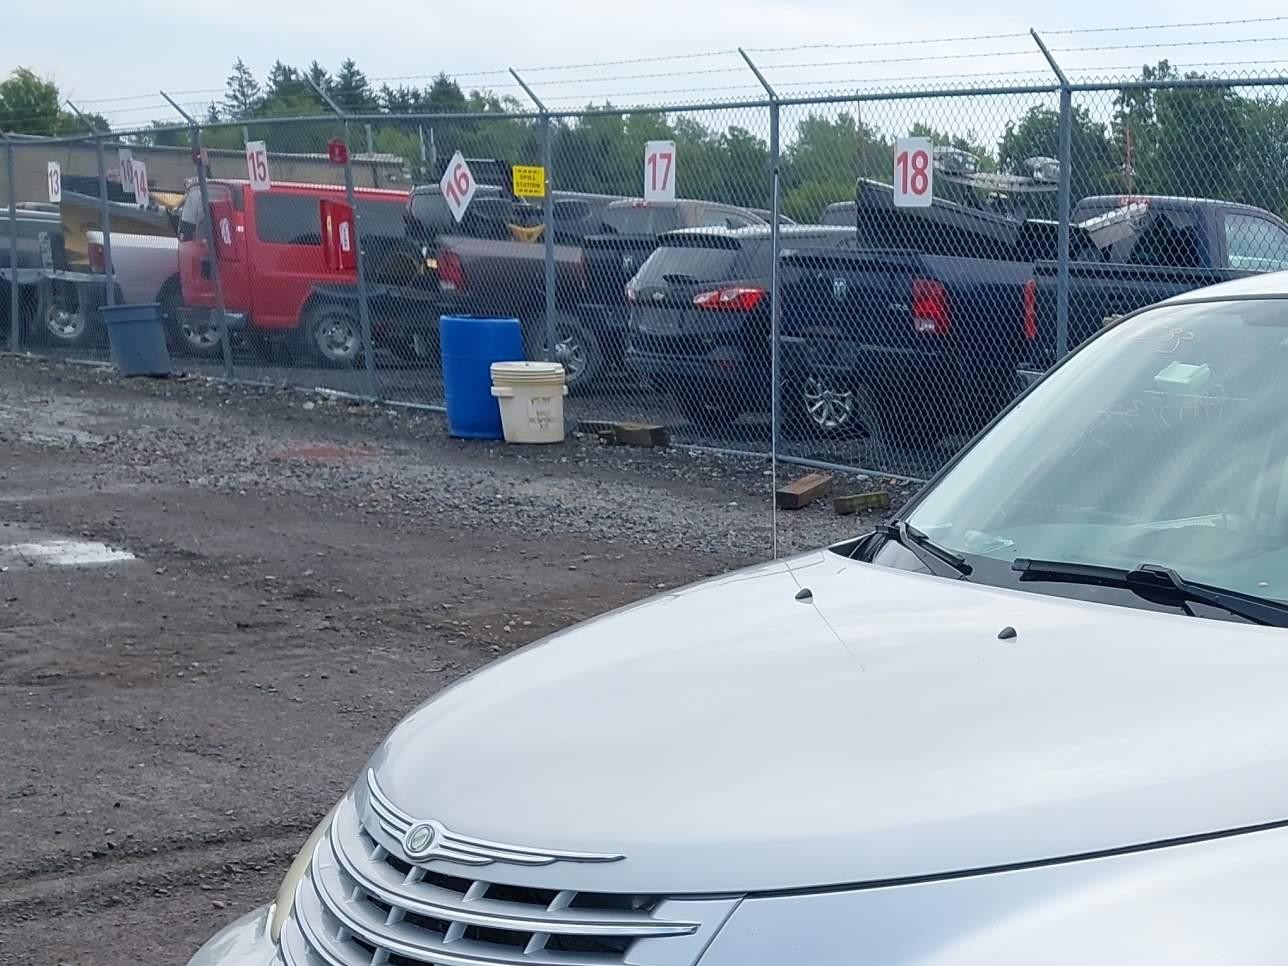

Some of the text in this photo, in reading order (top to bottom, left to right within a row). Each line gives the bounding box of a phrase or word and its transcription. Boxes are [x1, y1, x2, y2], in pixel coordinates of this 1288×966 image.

[50, 169, 60, 195] 13
[134, 169, 147, 198] 14
[248, 150, 267, 182] 15
[647, 152, 673, 191] 17
[897, 150, 929, 196] 18
[446, 163, 470, 208] 16
